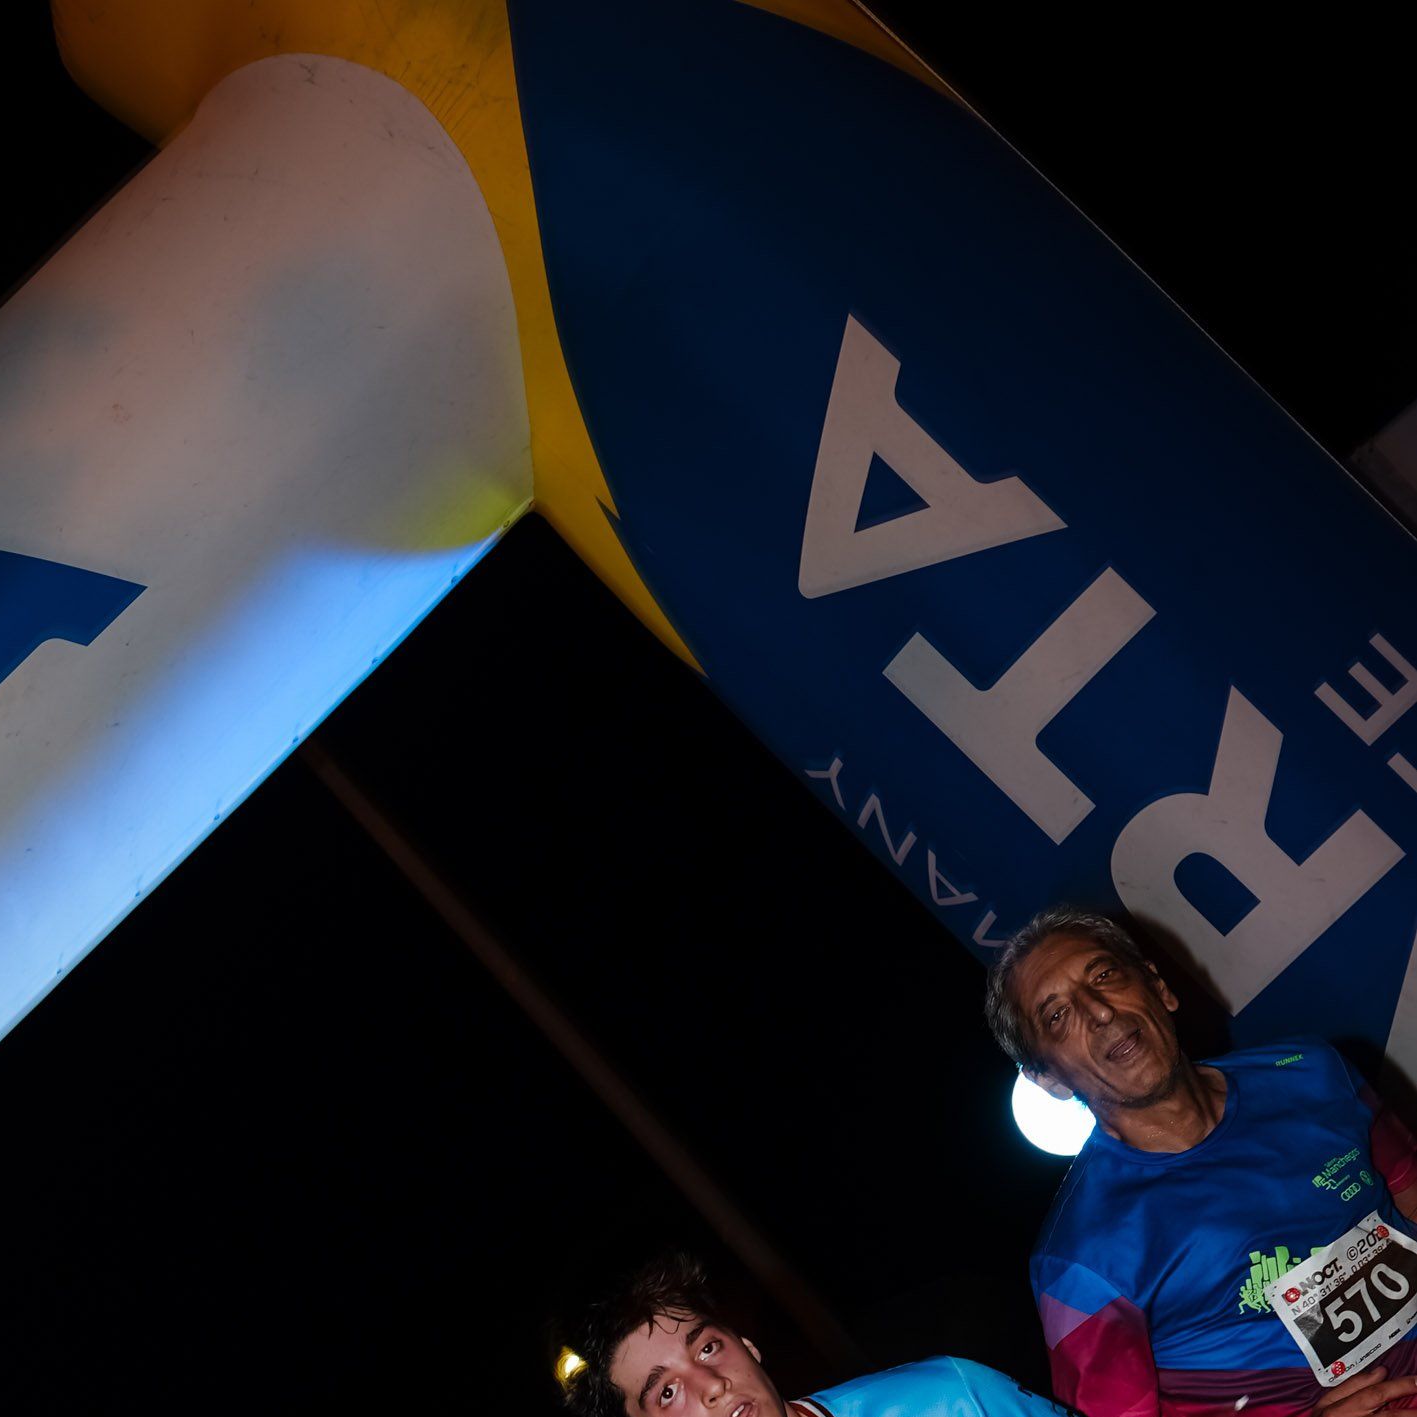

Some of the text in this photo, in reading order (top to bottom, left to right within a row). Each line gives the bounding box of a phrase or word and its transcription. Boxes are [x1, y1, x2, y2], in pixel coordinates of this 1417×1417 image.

[797, 312, 1417, 1084] RTA
[1282, 1258, 1344, 1305] NOCT.
[1324, 1262, 1410, 1343] 570
